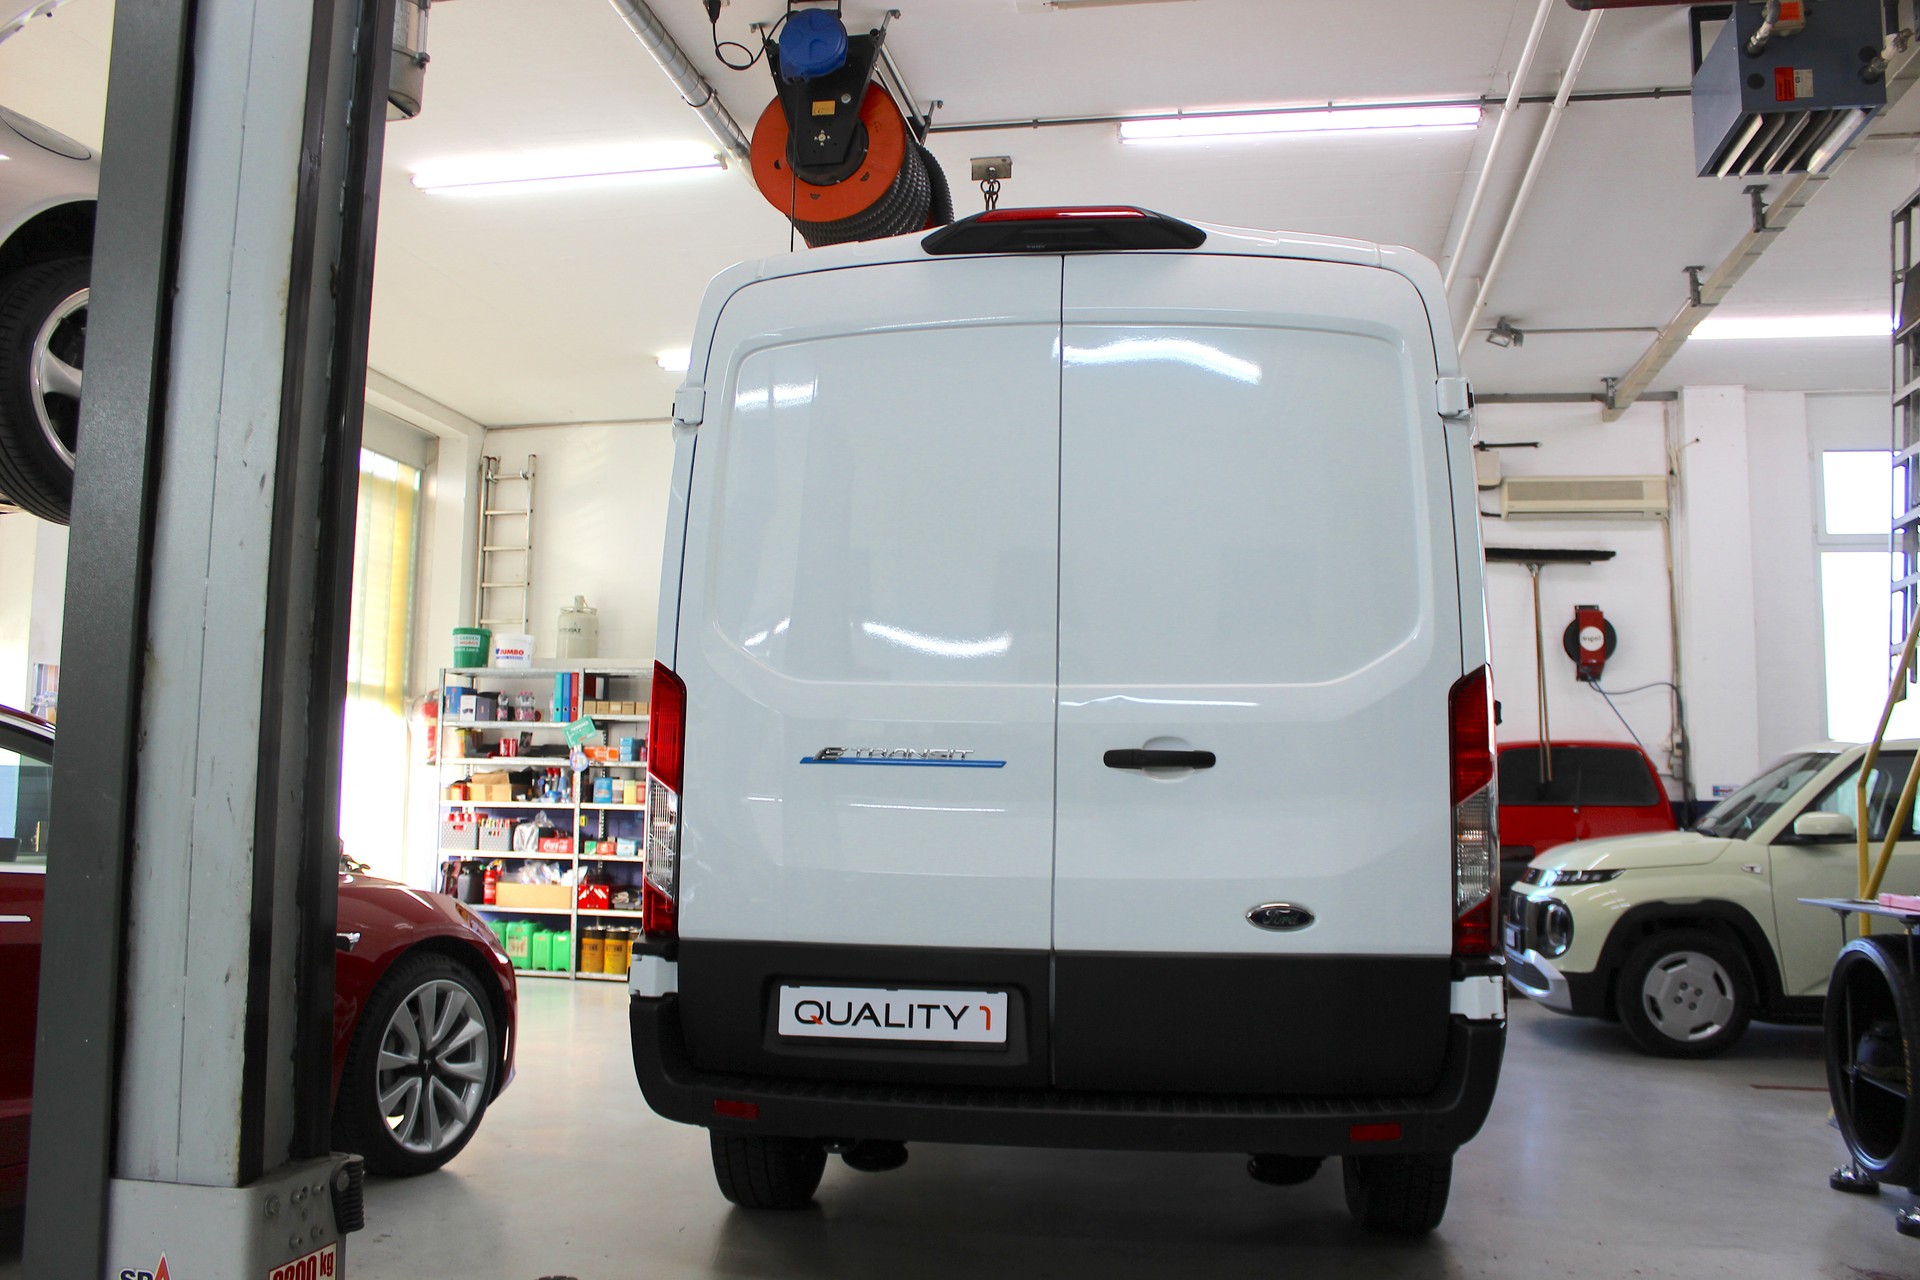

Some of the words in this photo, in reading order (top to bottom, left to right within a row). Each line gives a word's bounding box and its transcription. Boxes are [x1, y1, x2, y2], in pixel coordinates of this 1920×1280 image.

[500, 648, 524, 656] JUMBO
[851, 747, 975, 761] TRANSIT
[794, 1000, 970, 1030] QUALITY
[979, 1005, 992, 1031] 1
[319, 1251, 334, 1277] kg
